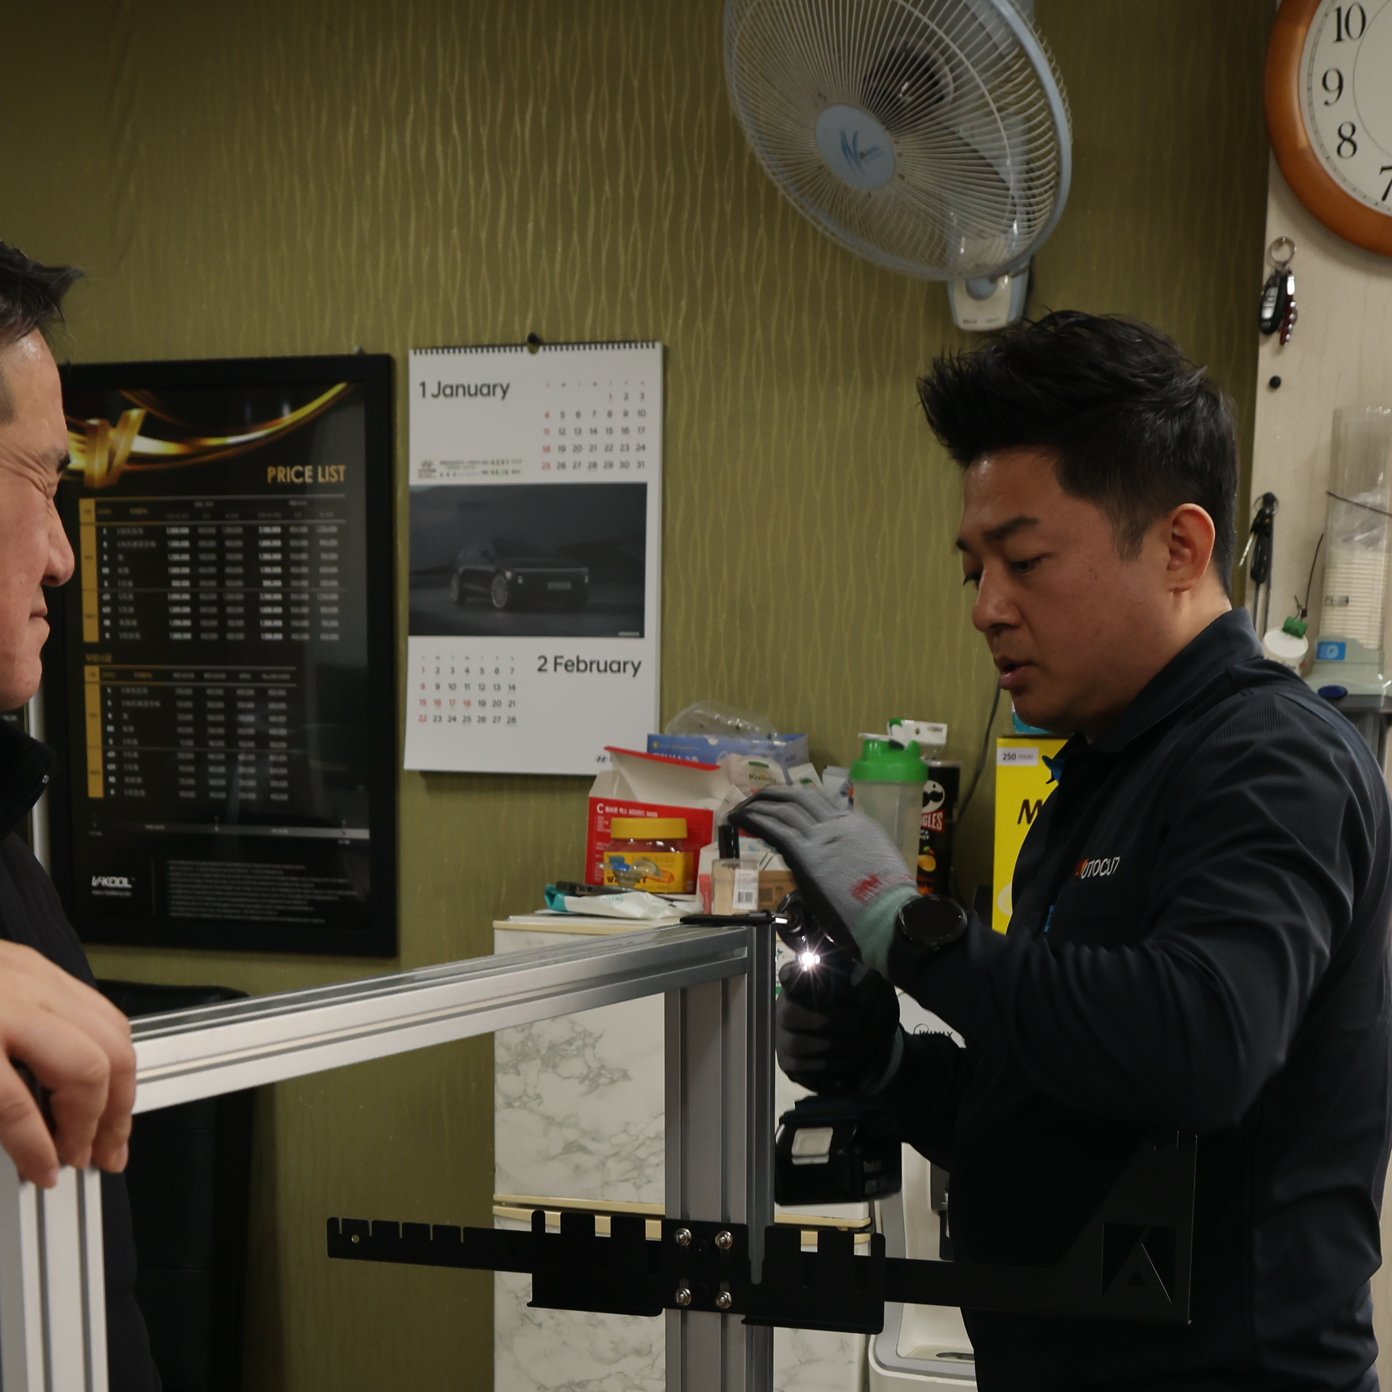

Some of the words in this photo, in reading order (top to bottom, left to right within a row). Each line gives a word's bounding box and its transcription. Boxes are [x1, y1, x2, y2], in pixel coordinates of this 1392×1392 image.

[1333, 0, 1367, 43] 10
[1321, 67, 1344, 106] 9
[1336, 121, 1358, 159] 8
[419, 380, 426, 398] 1
[431, 380, 510, 402] January
[267, 465, 313, 483] PRICE
[317, 465, 347, 483] LIST
[537, 655, 548, 672] 2
[553, 655, 642, 678] February
[1002, 753, 1017, 761] 250
[922, 812, 944, 831] GLES
